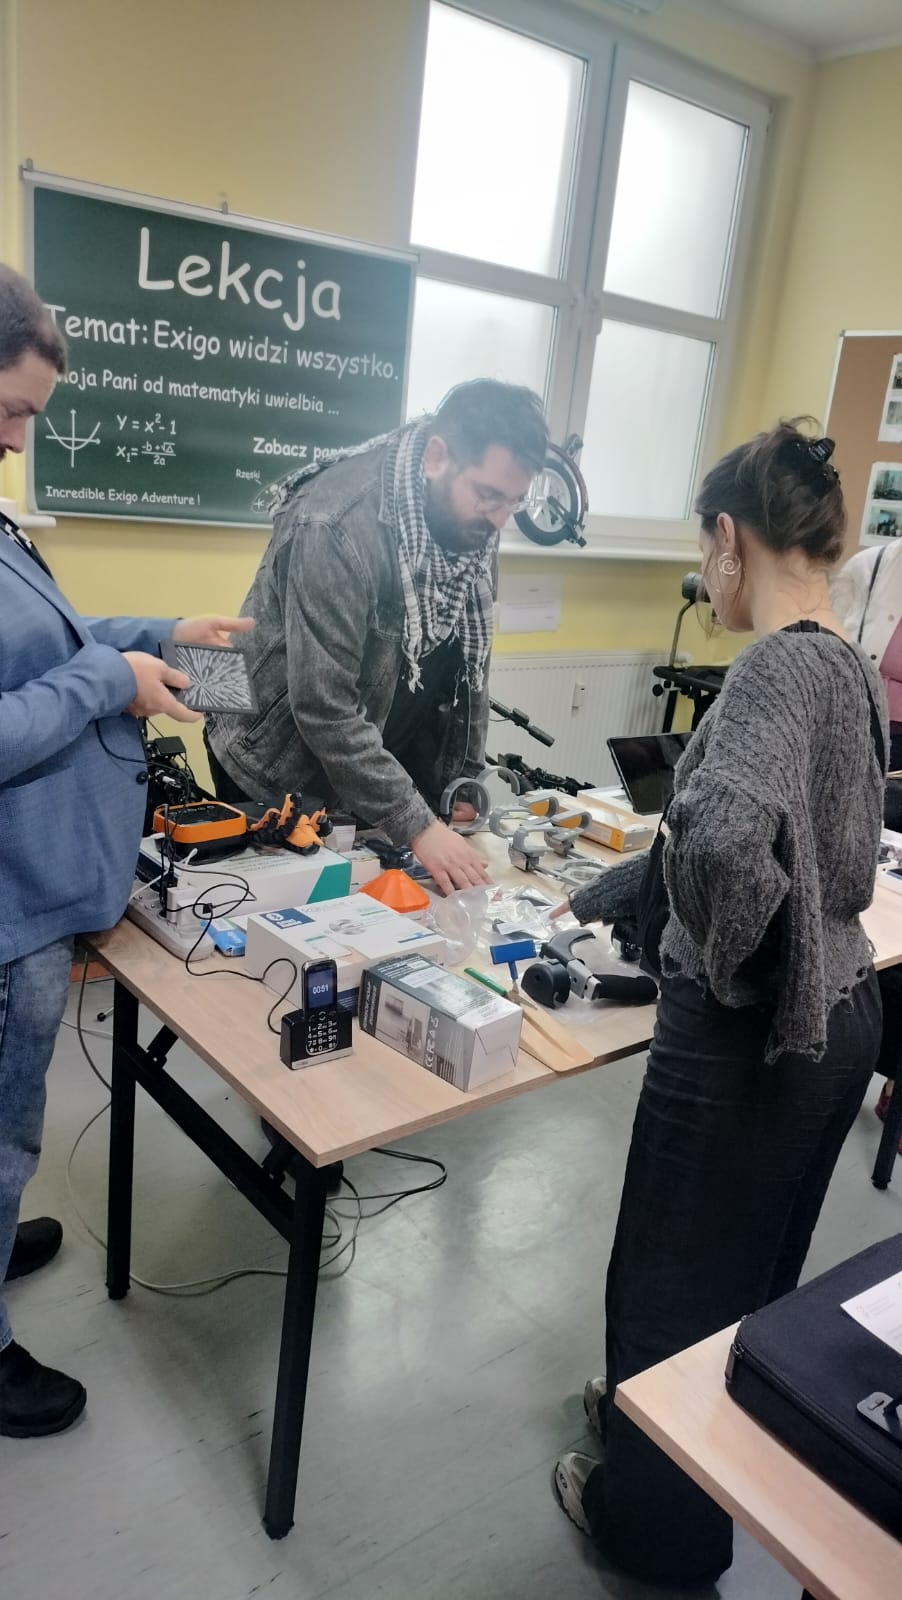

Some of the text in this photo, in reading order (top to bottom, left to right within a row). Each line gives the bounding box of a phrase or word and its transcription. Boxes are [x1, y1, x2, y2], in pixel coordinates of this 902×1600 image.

[138, 226, 341, 331] Lekcja
[43, 303, 399, 380] Temat: Exigo widzi wszystko.
[102, 369, 138, 391] Pani
[143, 375, 164, 394] od
[168, 381, 261, 409] matematyki
[265, 392, 324, 413] uwielbia
[253, 436, 308, 458] Zobacz
[45, 485, 106, 500] Incredible
[108, 488, 138, 505] Exigo
[141, 491, 196, 506] Adventure
[312, 983, 329, 995] 00:51
